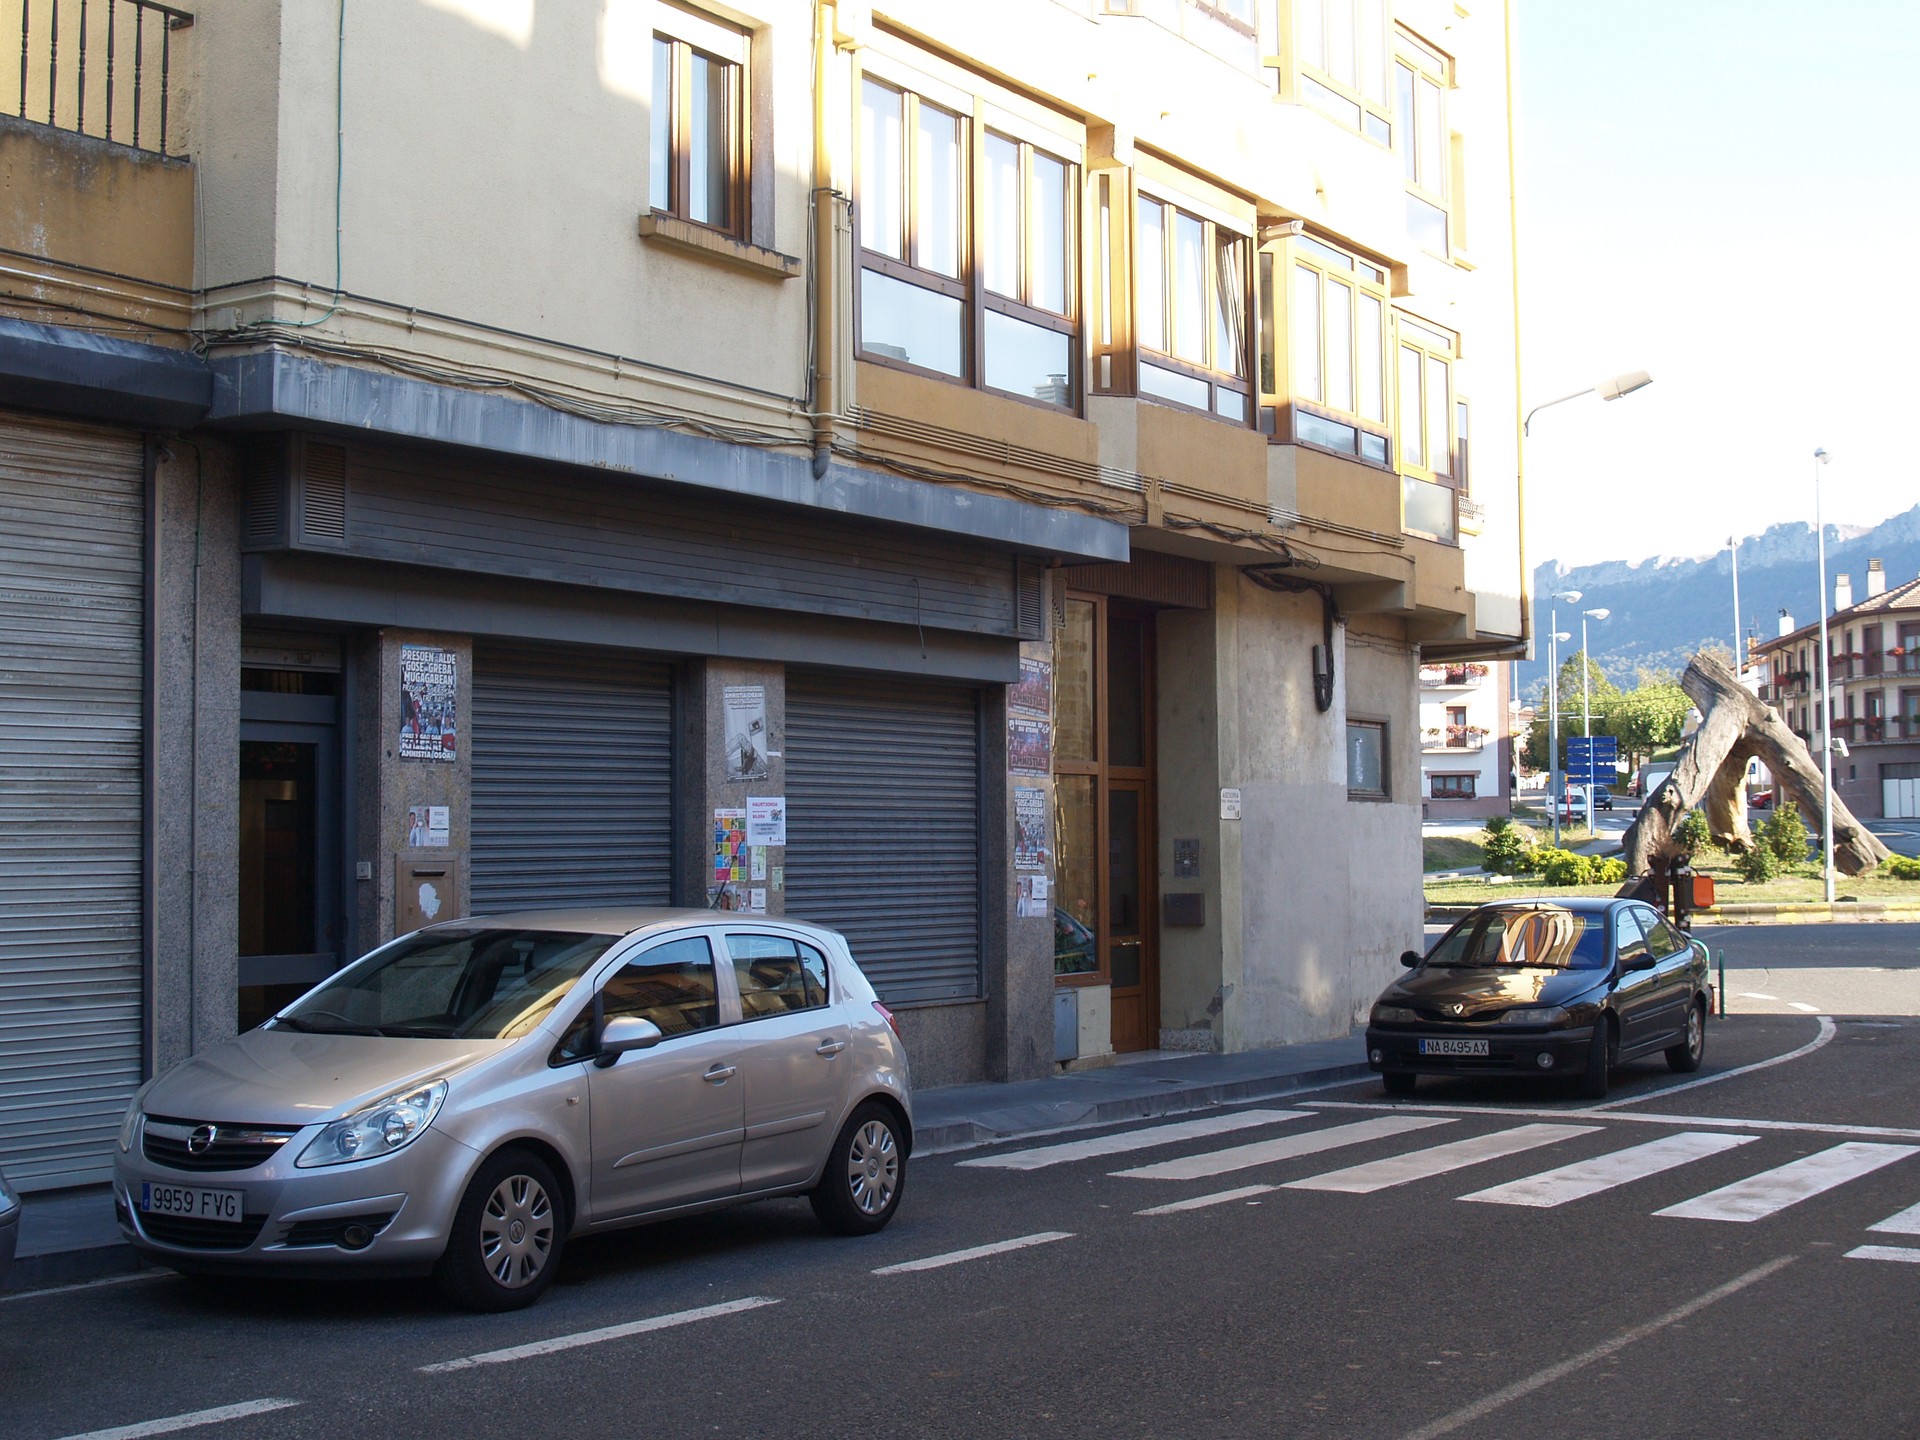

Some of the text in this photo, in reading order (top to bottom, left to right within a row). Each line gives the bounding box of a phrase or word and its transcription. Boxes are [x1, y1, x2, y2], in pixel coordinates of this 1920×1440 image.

[402, 650, 456, 664] PRESOEN ALDE
[406, 661, 452, 674] GOSE GREBA
[404, 672, 453, 685] MUGAGABEAN
[401, 750, 431, 759] AMNISTIA
[1427, 1041, 1487, 1054] NA 8495 AX
[153, 1187, 236, 1217] 9959 FVG
